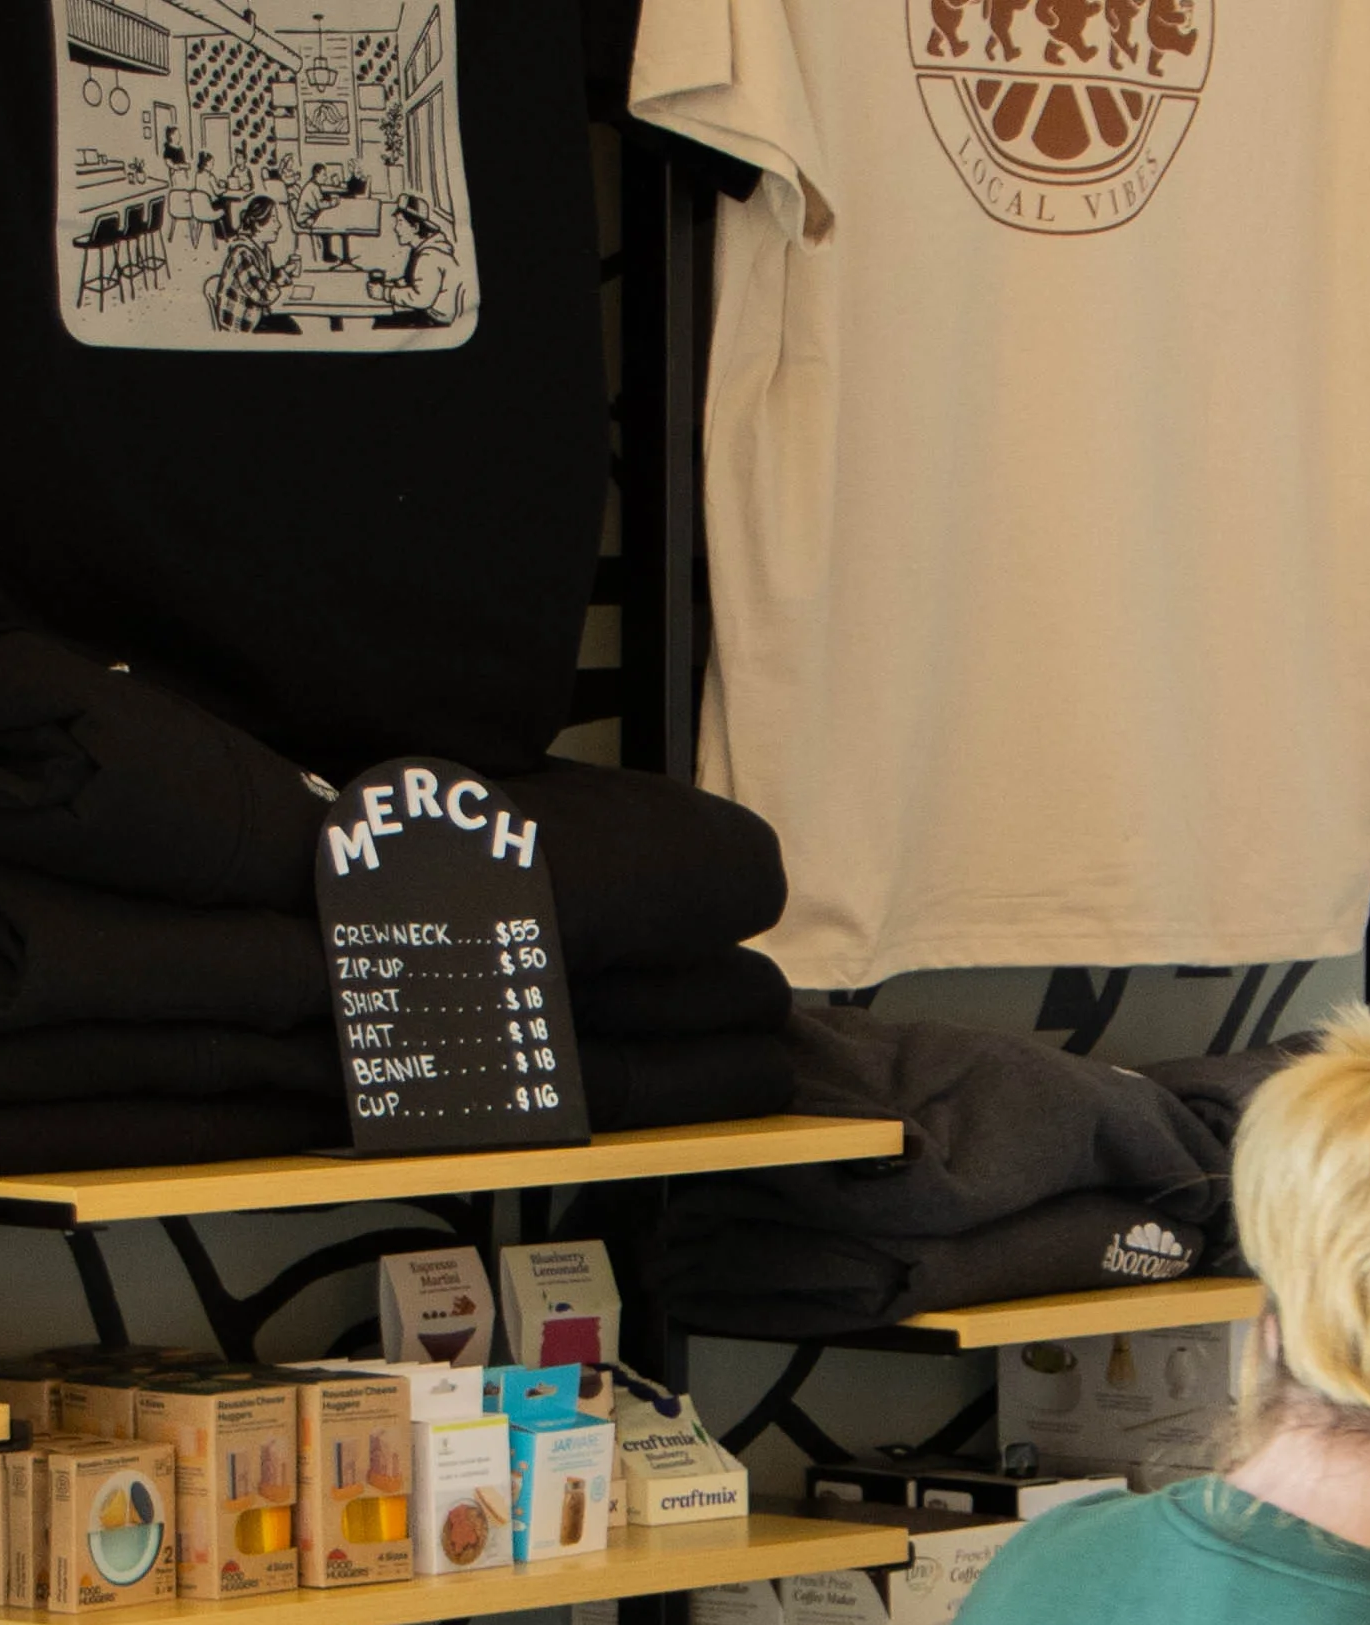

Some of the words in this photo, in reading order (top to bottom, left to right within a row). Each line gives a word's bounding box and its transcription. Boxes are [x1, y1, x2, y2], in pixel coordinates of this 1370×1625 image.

[956, 135, 1055, 222] LOCAL
[1082, 147, 1160, 220] VIBES
[328, 767, 536, 875] MERCH
[495, 918, 540, 947] $55
[336, 956, 405, 980] ZIP-UP
[341, 988, 400, 1015] SHIRT
[348, 1023, 394, 1049] HAT
[352, 1055, 438, 1085] BEANIE
[357, 1092, 400, 1118] CUP
[622, 1431, 698, 1452] craftmix
[661, 1487, 737, 1511] craftmix
